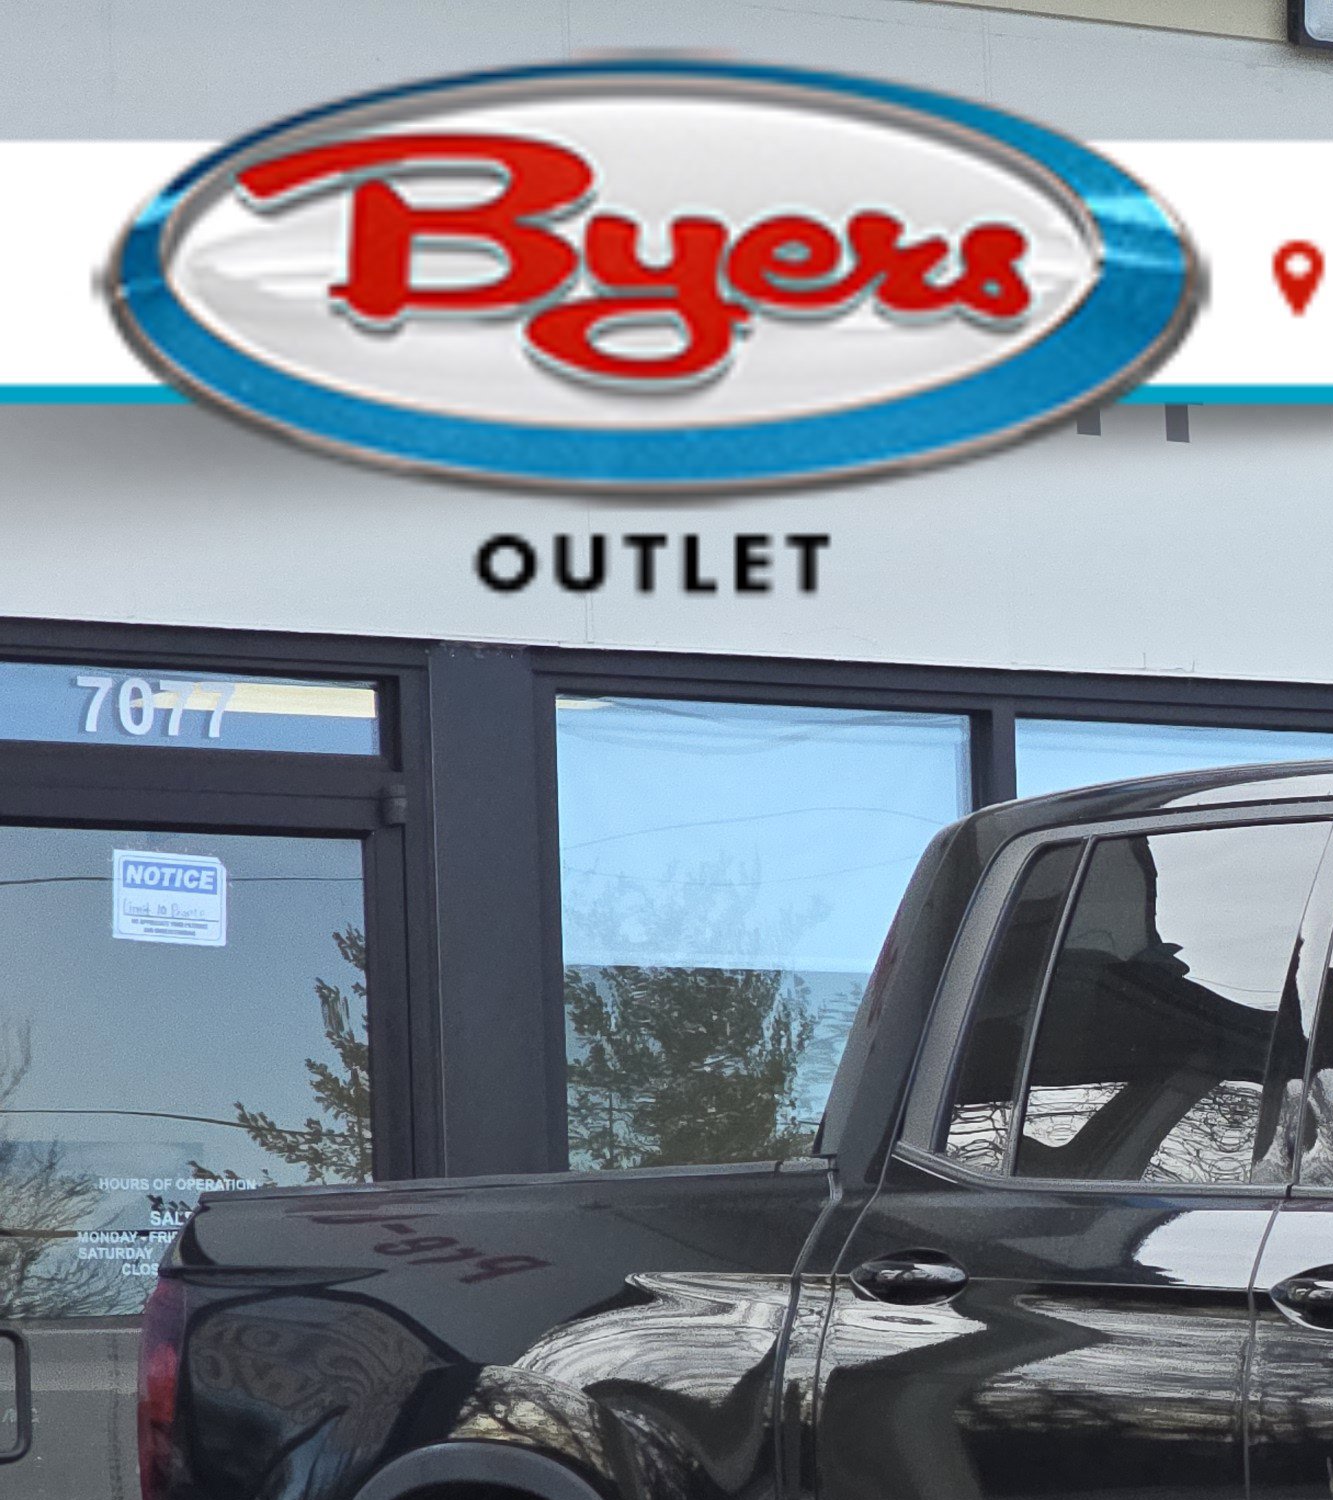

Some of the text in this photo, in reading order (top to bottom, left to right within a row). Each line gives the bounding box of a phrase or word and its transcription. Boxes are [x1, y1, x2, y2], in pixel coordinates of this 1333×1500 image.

[77, 675, 235, 738] 7077
[125, 864, 216, 891] NOTICE
[99, 1178, 256, 1191] HOURS OF OPERATION
[78, 1230, 138, 1244] MONDAY
[78, 1246, 154, 1260] SATURDAY
[121, 1262, 159, 1276] CLOS
